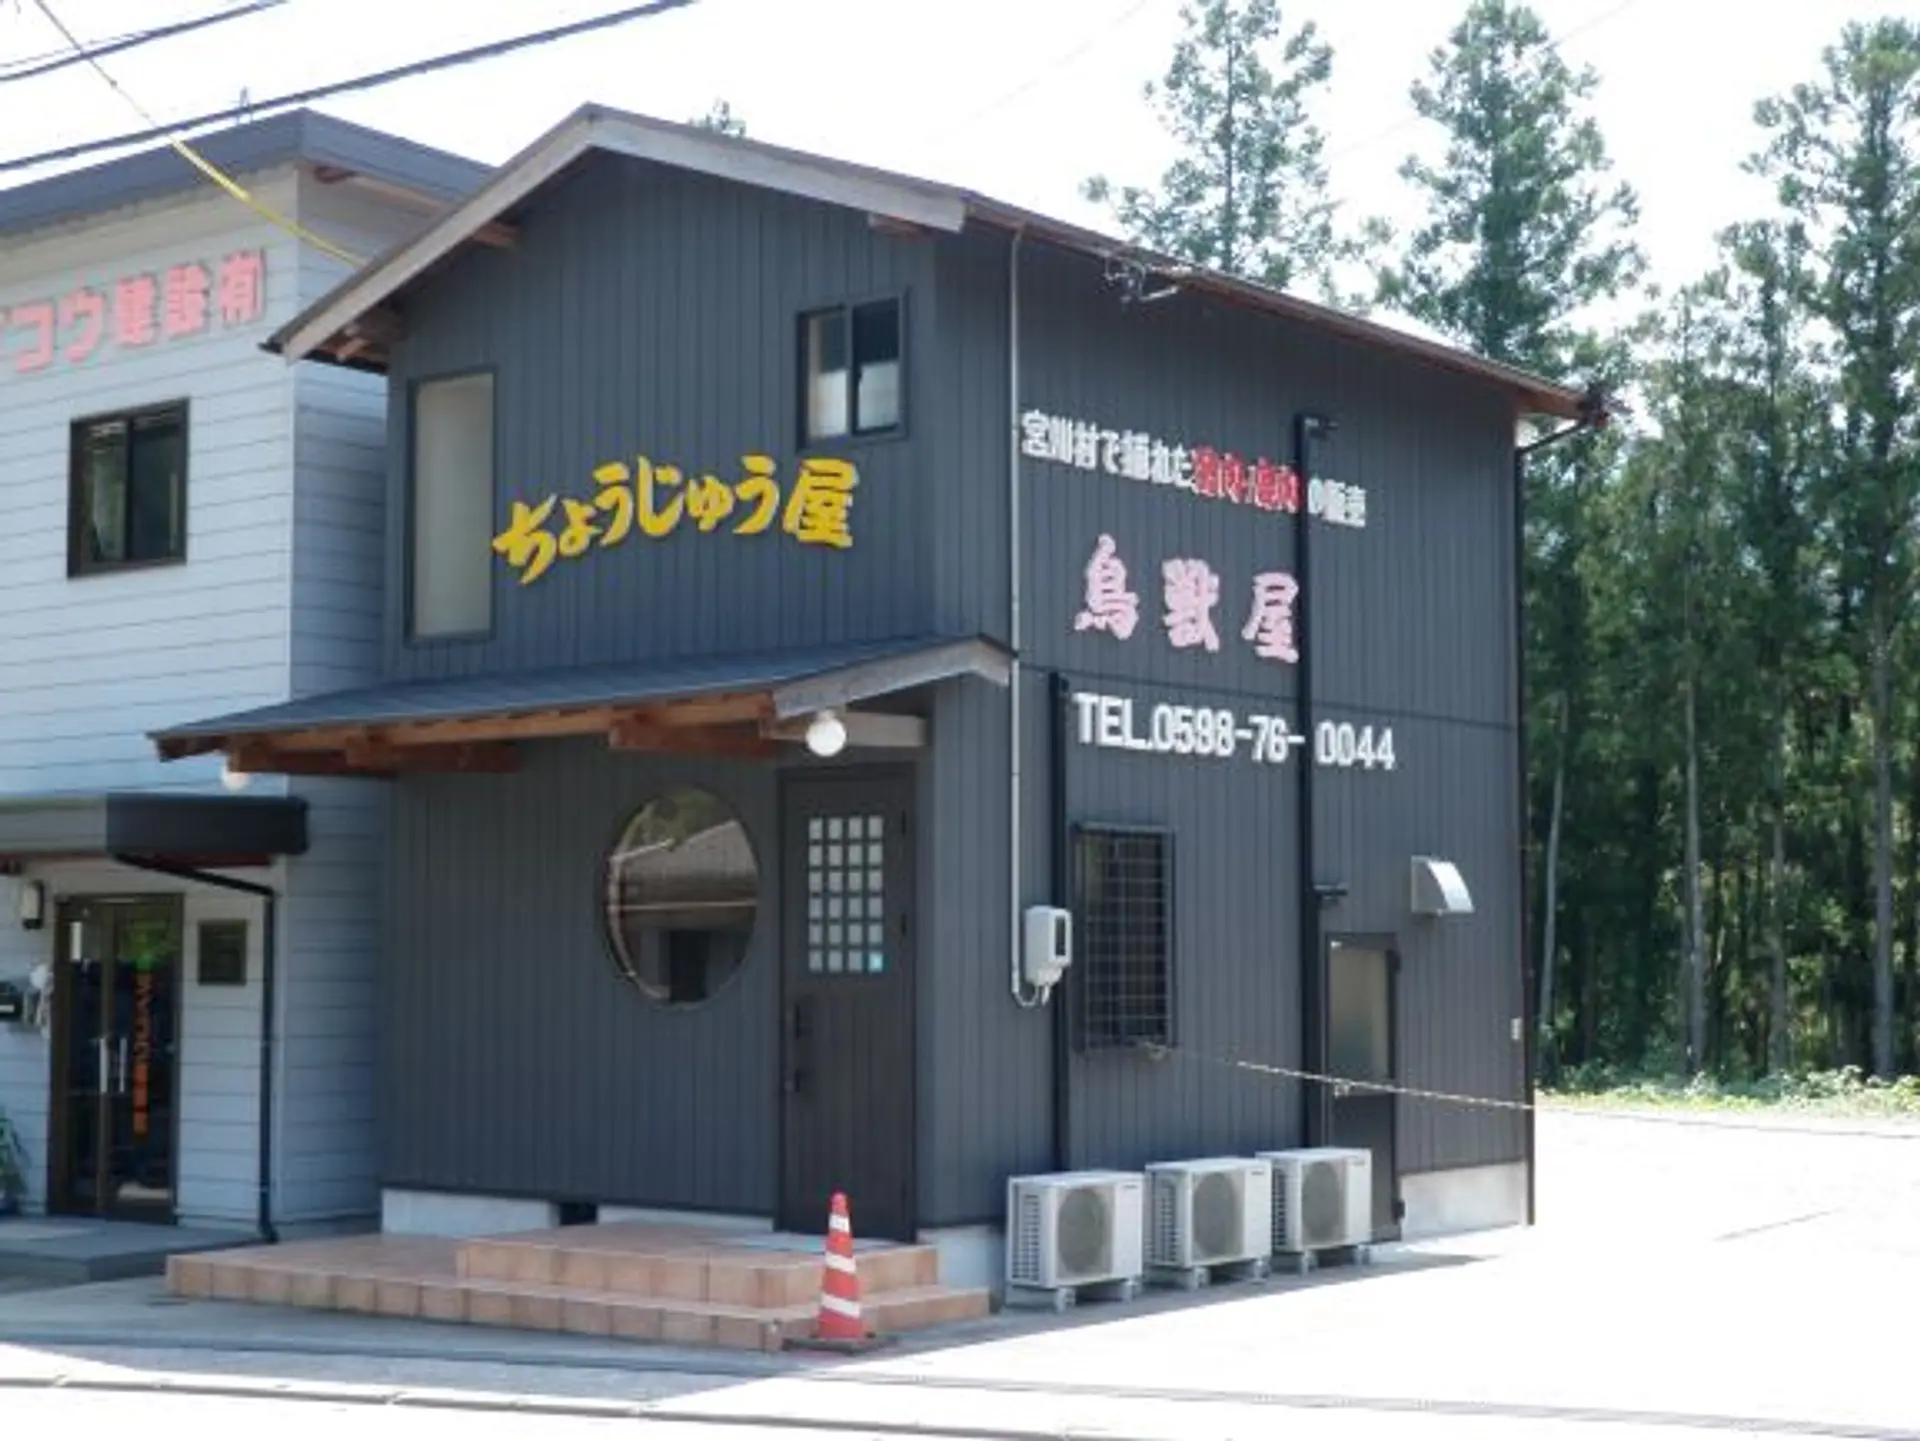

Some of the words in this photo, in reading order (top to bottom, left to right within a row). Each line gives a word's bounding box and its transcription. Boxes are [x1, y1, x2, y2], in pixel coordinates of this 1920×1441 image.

[492, 455, 859, 585] ちょうじゅう屋
[1074, 533, 1299, 663] 鳥獣屋
